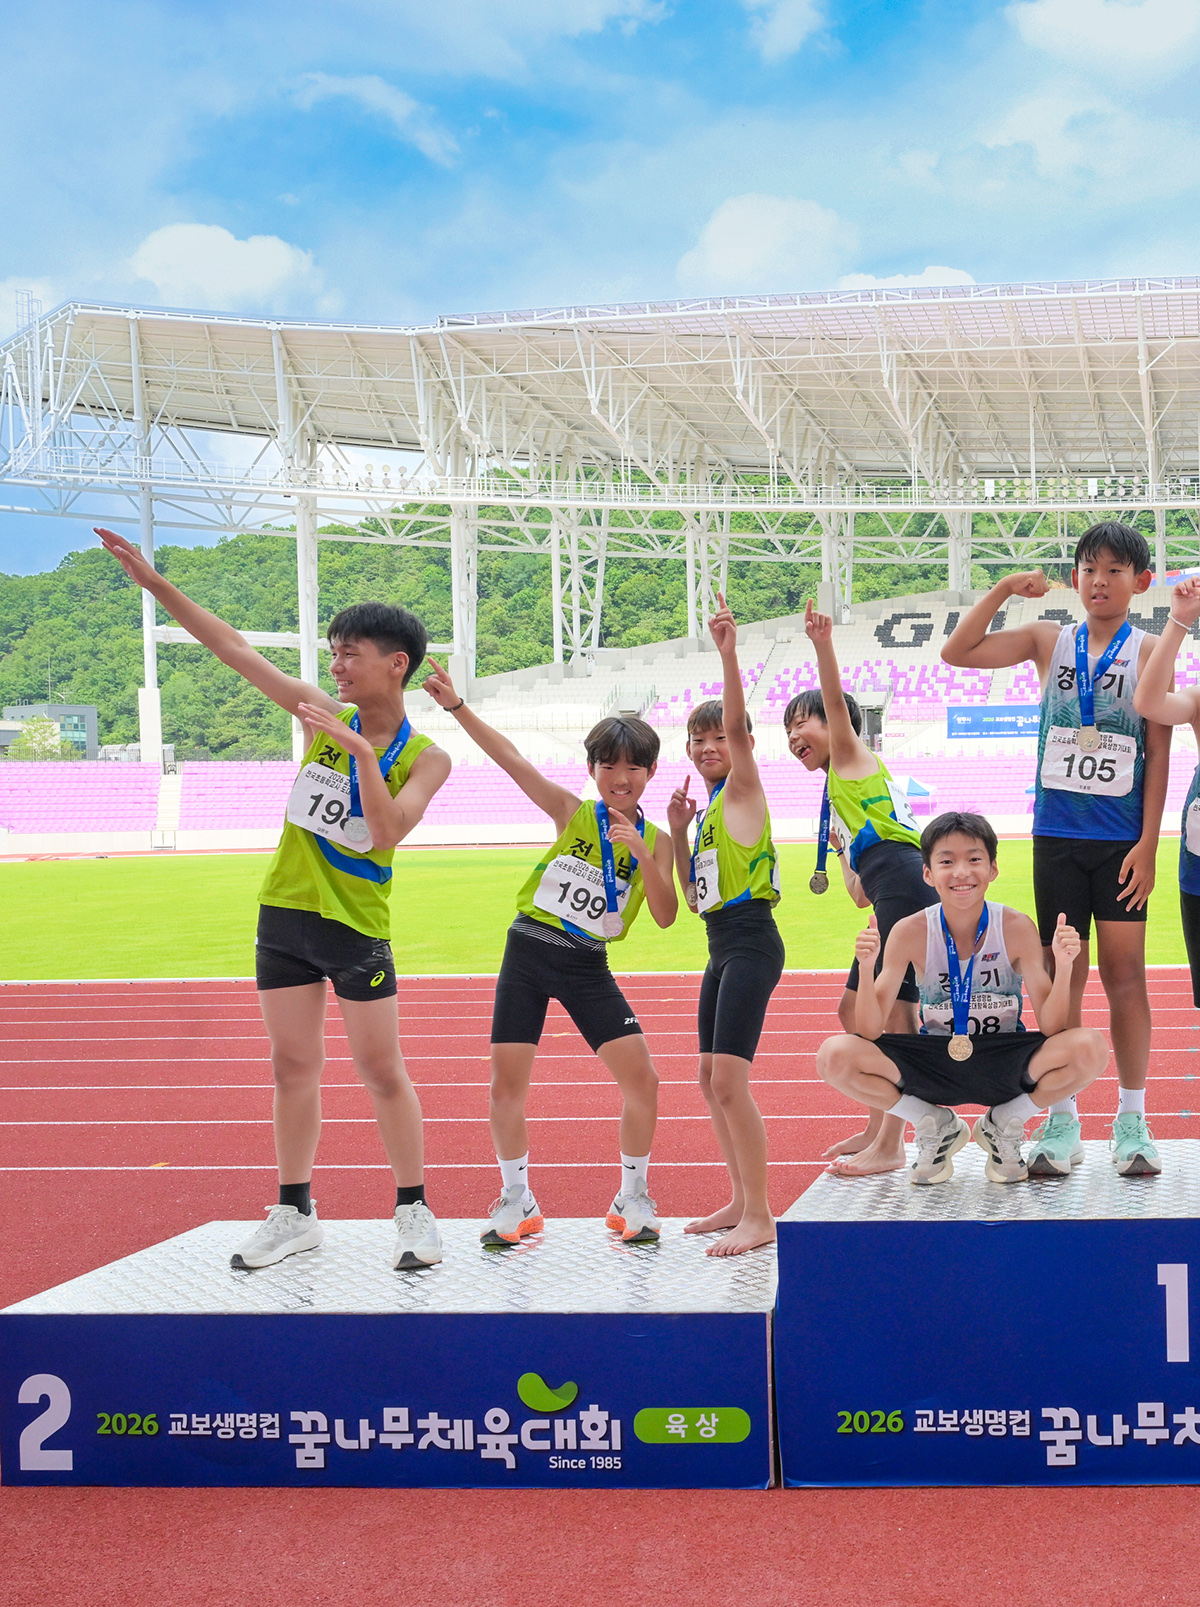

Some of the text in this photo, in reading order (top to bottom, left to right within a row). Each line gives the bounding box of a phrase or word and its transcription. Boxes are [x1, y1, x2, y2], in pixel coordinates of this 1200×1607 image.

[1057, 665, 1125, 698] 경기
[328, 772, 344, 784] 2026
[1063, 753, 1117, 783] 105
[575, 861, 589, 872] 2026
[557, 881, 607, 920] 199
[1157, 1263, 1190, 1362] 1
[18, 1373, 73, 1471] 2
[96, 1404, 621, 1469] 2026 교보생명컵 꿈나무체육대회
[836, 1410, 904, 1433] 2026
[913, 1409, 1031, 1436] 교보생명컵
[549, 1456, 622, 1470] Since 1985
